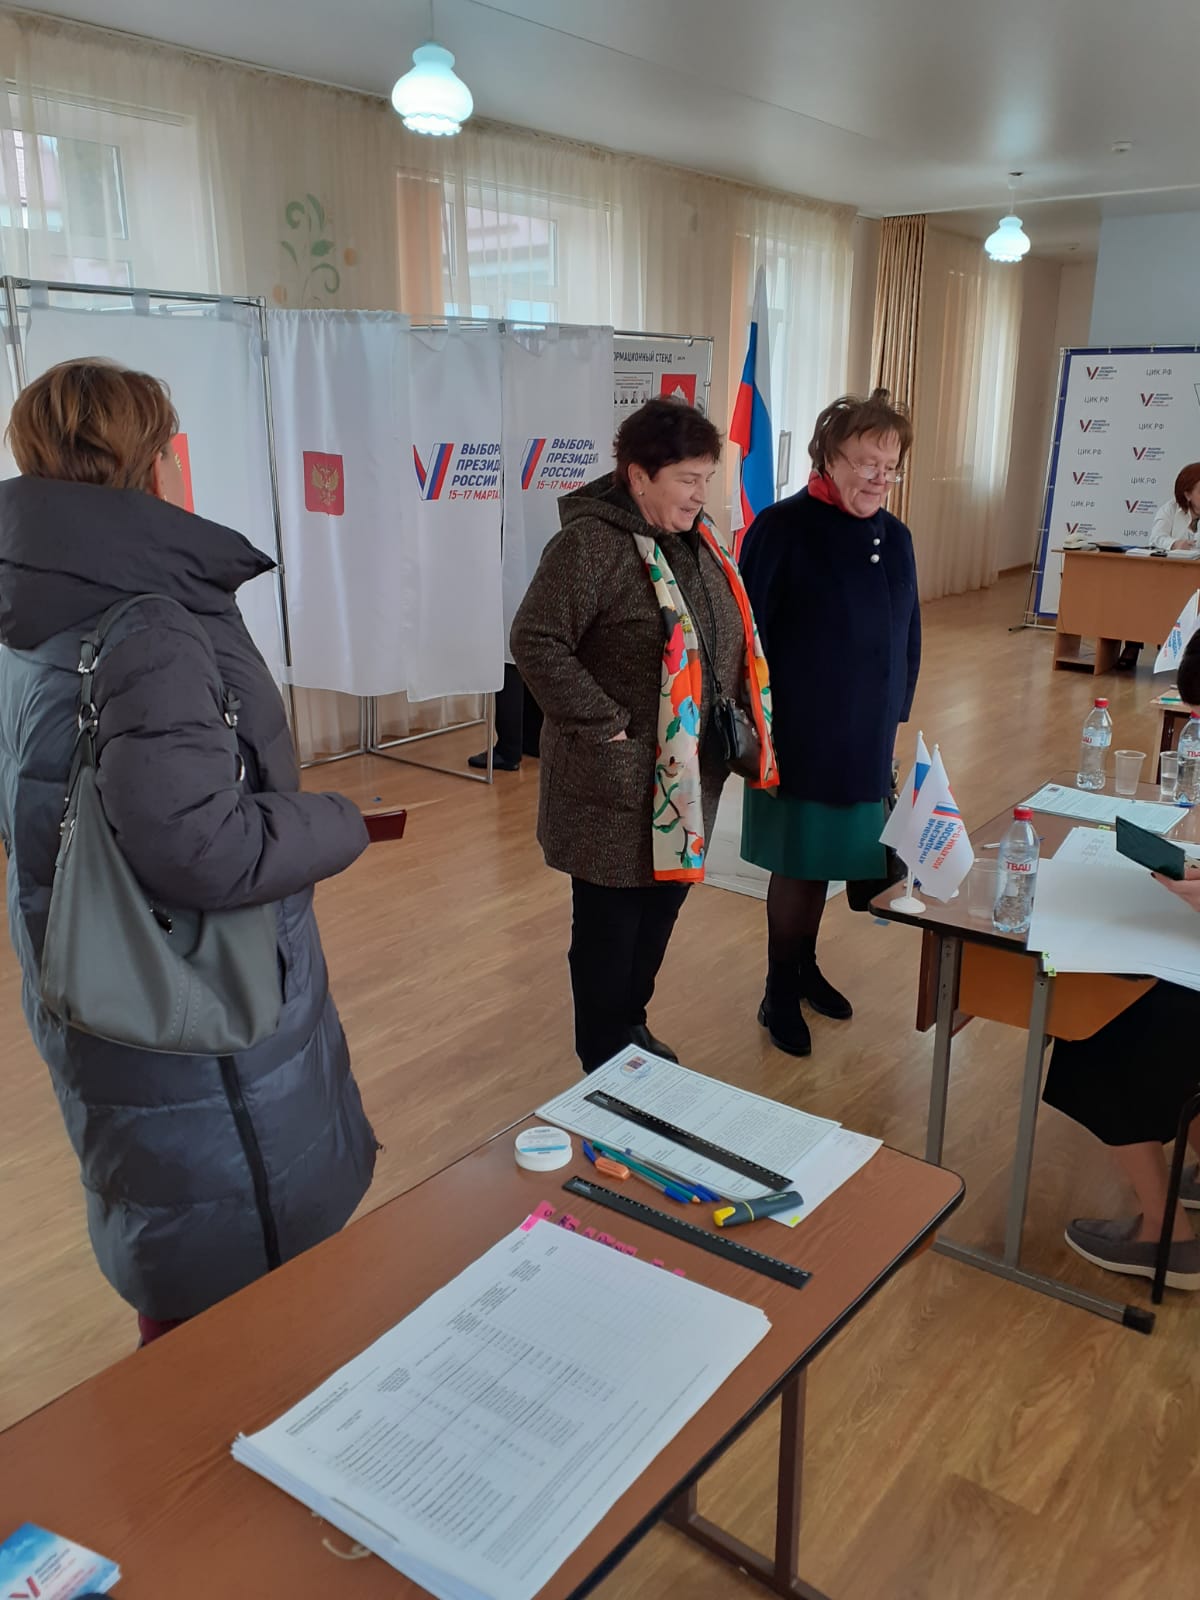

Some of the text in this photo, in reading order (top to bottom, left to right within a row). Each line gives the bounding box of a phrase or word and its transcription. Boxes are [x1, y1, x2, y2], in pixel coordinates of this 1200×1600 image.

[655, 352, 672, 363] СТЕНД
[456, 459, 500, 472] ПРЕЗИД
[540, 467, 586, 478] РОССИИ
[451, 474, 497, 486] РОССИИ
[1006, 861, 1031, 872] TBAU
